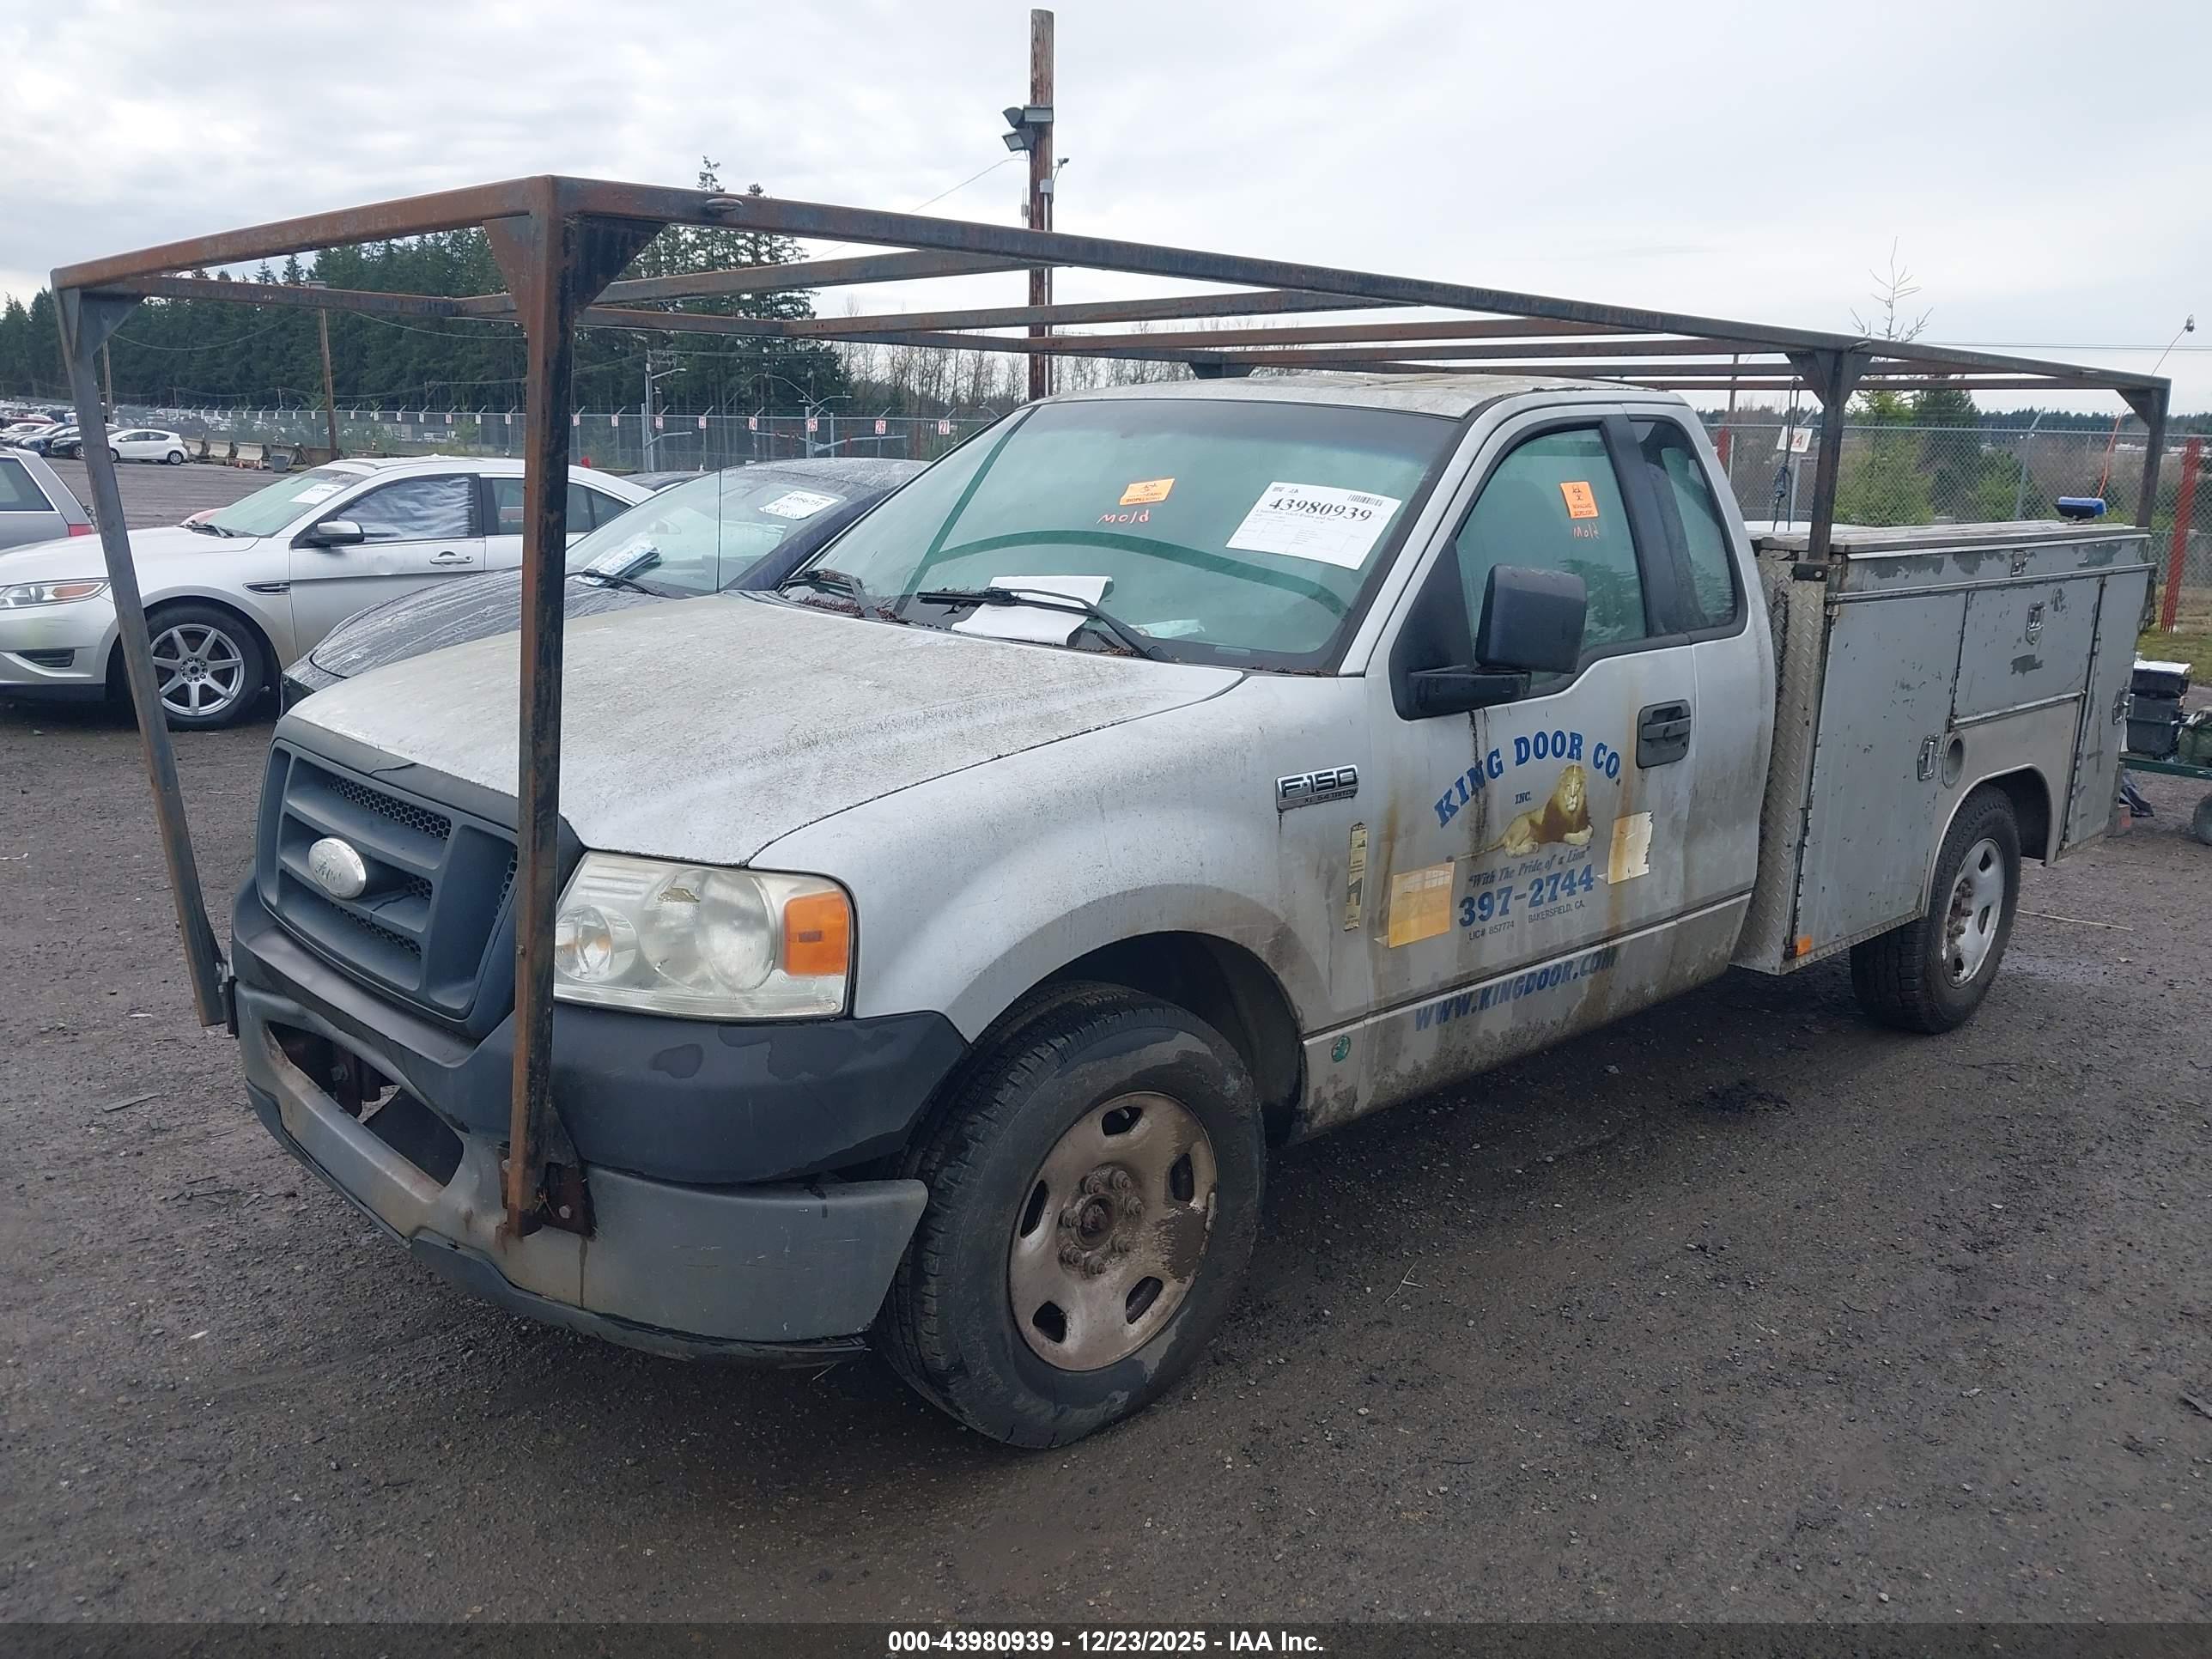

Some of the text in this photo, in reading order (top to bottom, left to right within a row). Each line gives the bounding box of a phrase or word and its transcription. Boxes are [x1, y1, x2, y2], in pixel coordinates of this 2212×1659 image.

[750, 416, 757, 429] 24
[808, 418, 817, 431] 25
[876, 421, 885, 434] 26
[939, 421, 949, 434] 27
[1269, 497, 1373, 522] 43980939
[1280, 767, 1358, 798] F-150
[1434, 730, 1620, 829] KING DOOR CO.
[1330, 787, 1358, 799] TRITON
[1515, 791, 1532, 805] INC.
[1498, 866, 1515, 881] The
[1518, 859, 1543, 877] Pride
[1545, 854, 1555, 871] of
[1458, 864, 1594, 927] 397-2744
[1528, 905, 1573, 923] BAKERSFIELD,
[1468, 928, 1486, 940] LIC#
[1415, 947, 1617, 1031] WWW.KINGDOOR.COM
